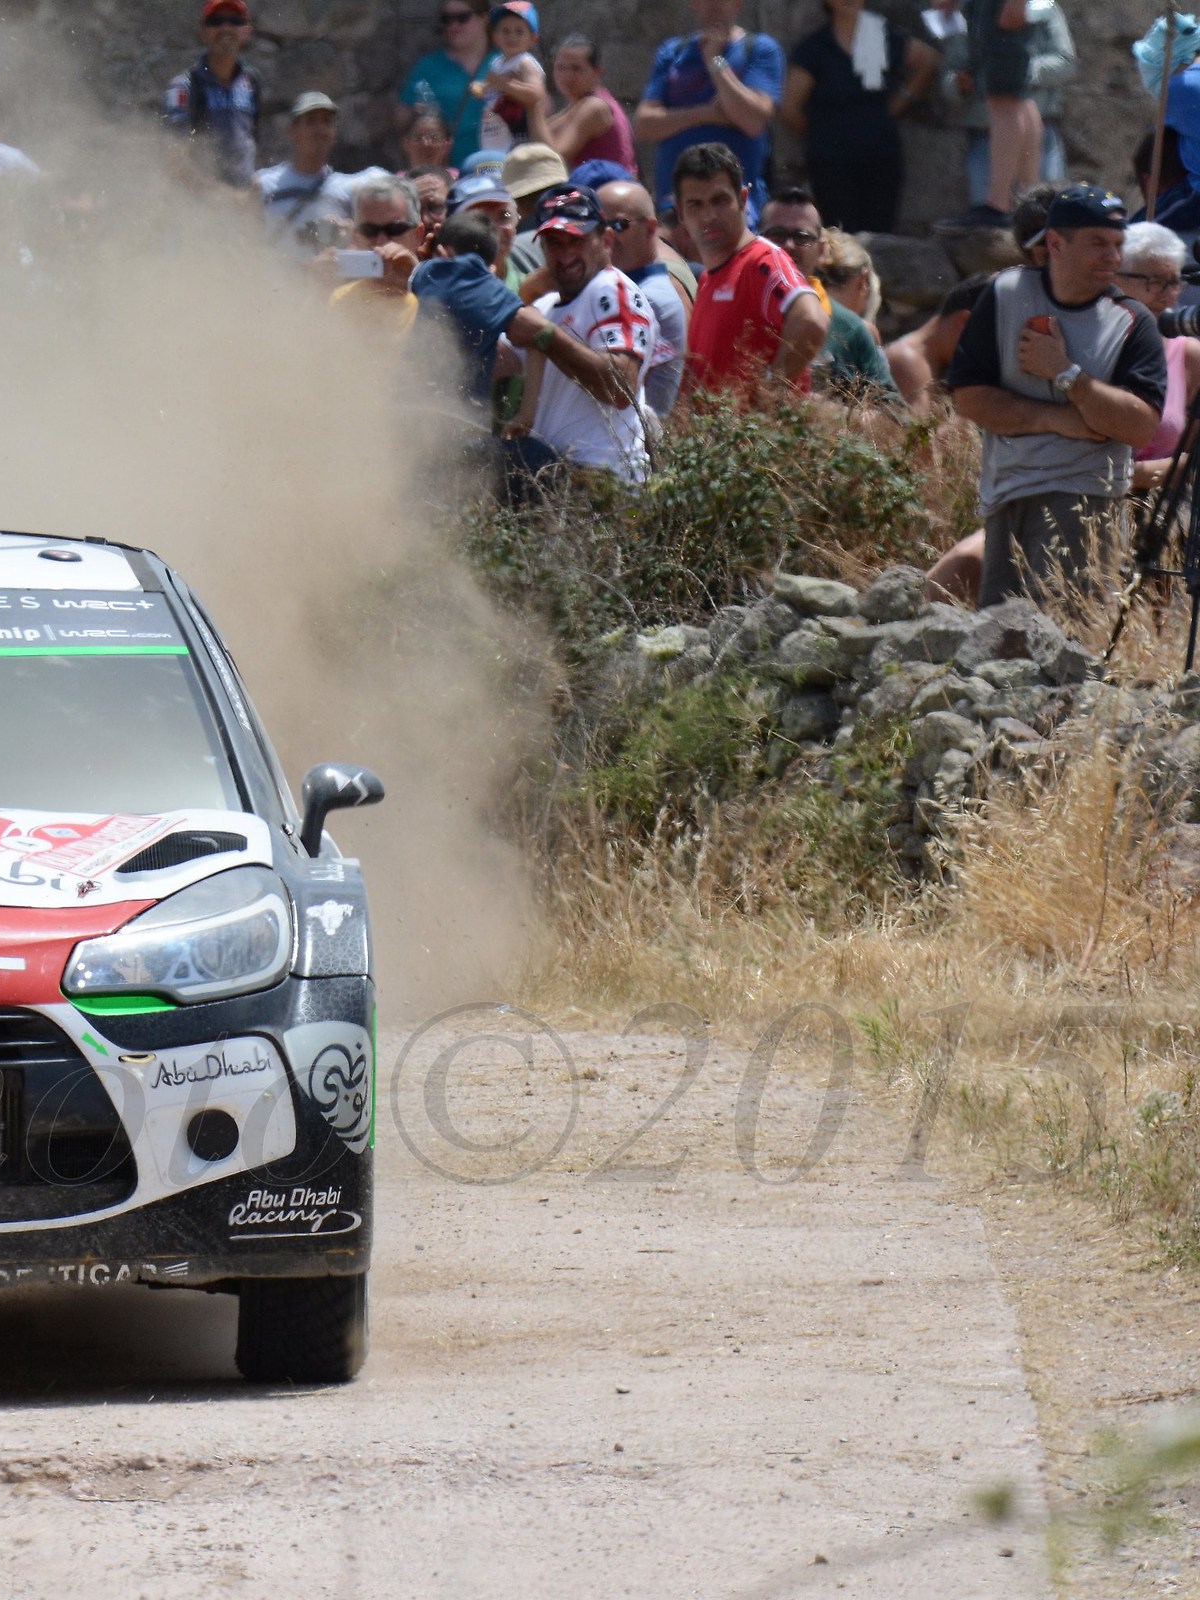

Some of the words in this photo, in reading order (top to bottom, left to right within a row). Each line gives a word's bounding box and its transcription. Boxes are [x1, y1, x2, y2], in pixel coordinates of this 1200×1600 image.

[246, 1189, 286, 1210] Abu
[289, 1185, 342, 1207] Dhabi
[228, 1202, 337, 1233] Racing
